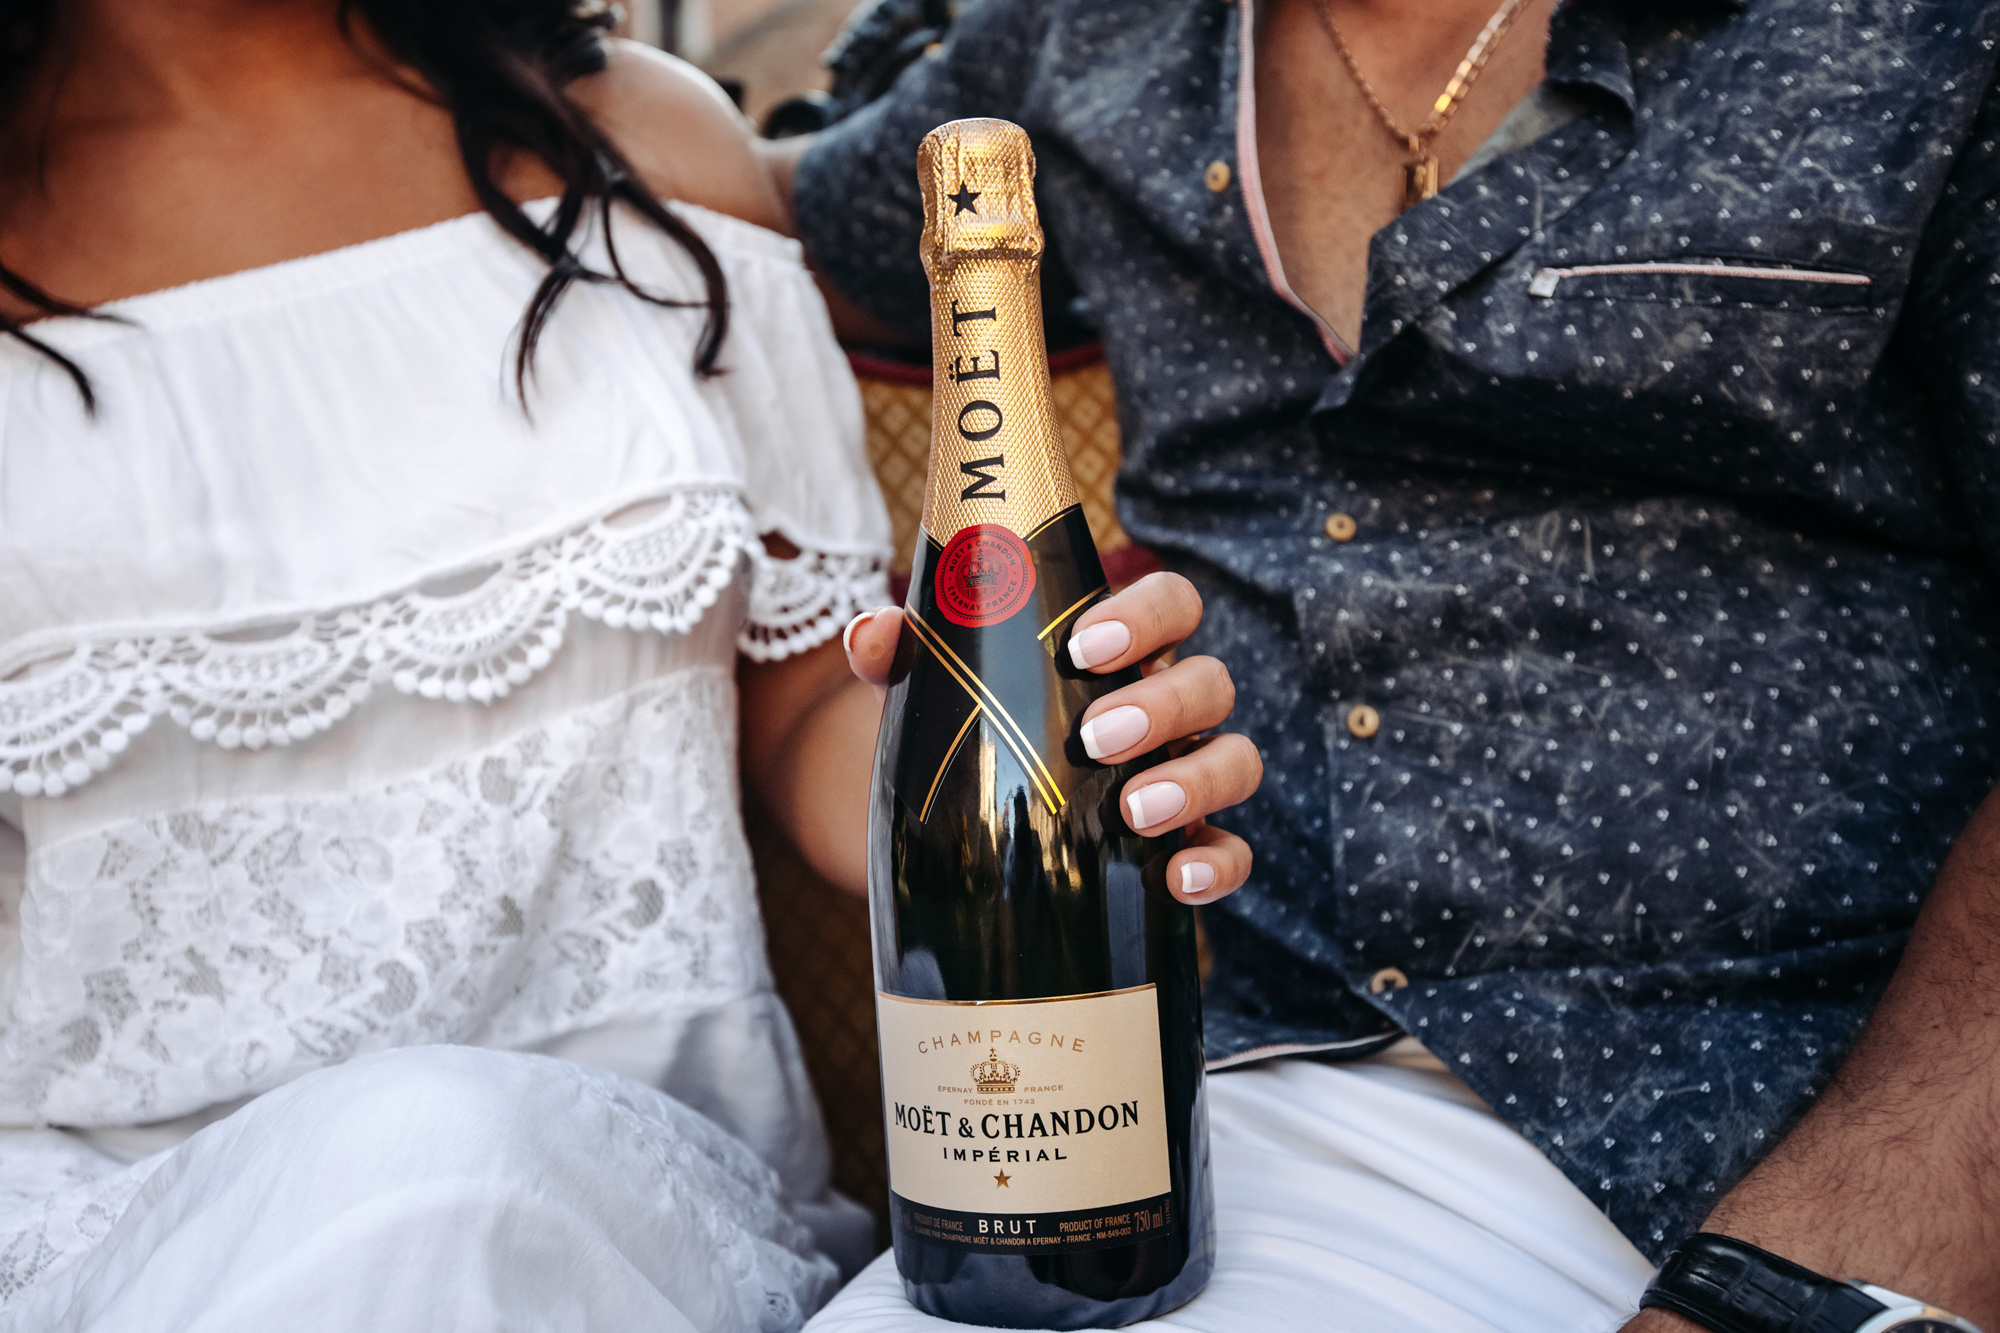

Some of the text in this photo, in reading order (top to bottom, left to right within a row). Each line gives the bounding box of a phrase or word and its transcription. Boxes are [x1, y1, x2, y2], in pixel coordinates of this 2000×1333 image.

[949, 299, 1006, 502] MOËT
[976, 540, 1017, 566] CHANDON
[986, 580, 1018, 609] FRANCE
[918, 1030, 1085, 1053] CHAMPAGNE
[937, 1084, 1064, 1094] ÉPERNAY FRANCE
[964, 1098, 994, 1106] FONDÉ
[894, 1100, 1139, 1139] MOËT & CHANDON
[943, 1146, 1067, 1163] IMPÉRIAL
[933, 1217, 941, 1229] DE
[941, 1219, 964, 1232] FRANCE
[978, 1219, 1037, 1235] BRUT
[1059, 1213, 1131, 1233] PRODUCT OF FRANCE
[1134, 1205, 1163, 1233] 750 ml
[941, 1231, 973, 1244] CHAMPAGNE
[990, 1236, 996, 1245] &
[996, 1236, 1026, 1246] CHANDON
[1066, 1233, 1092, 1244] FRANCE
